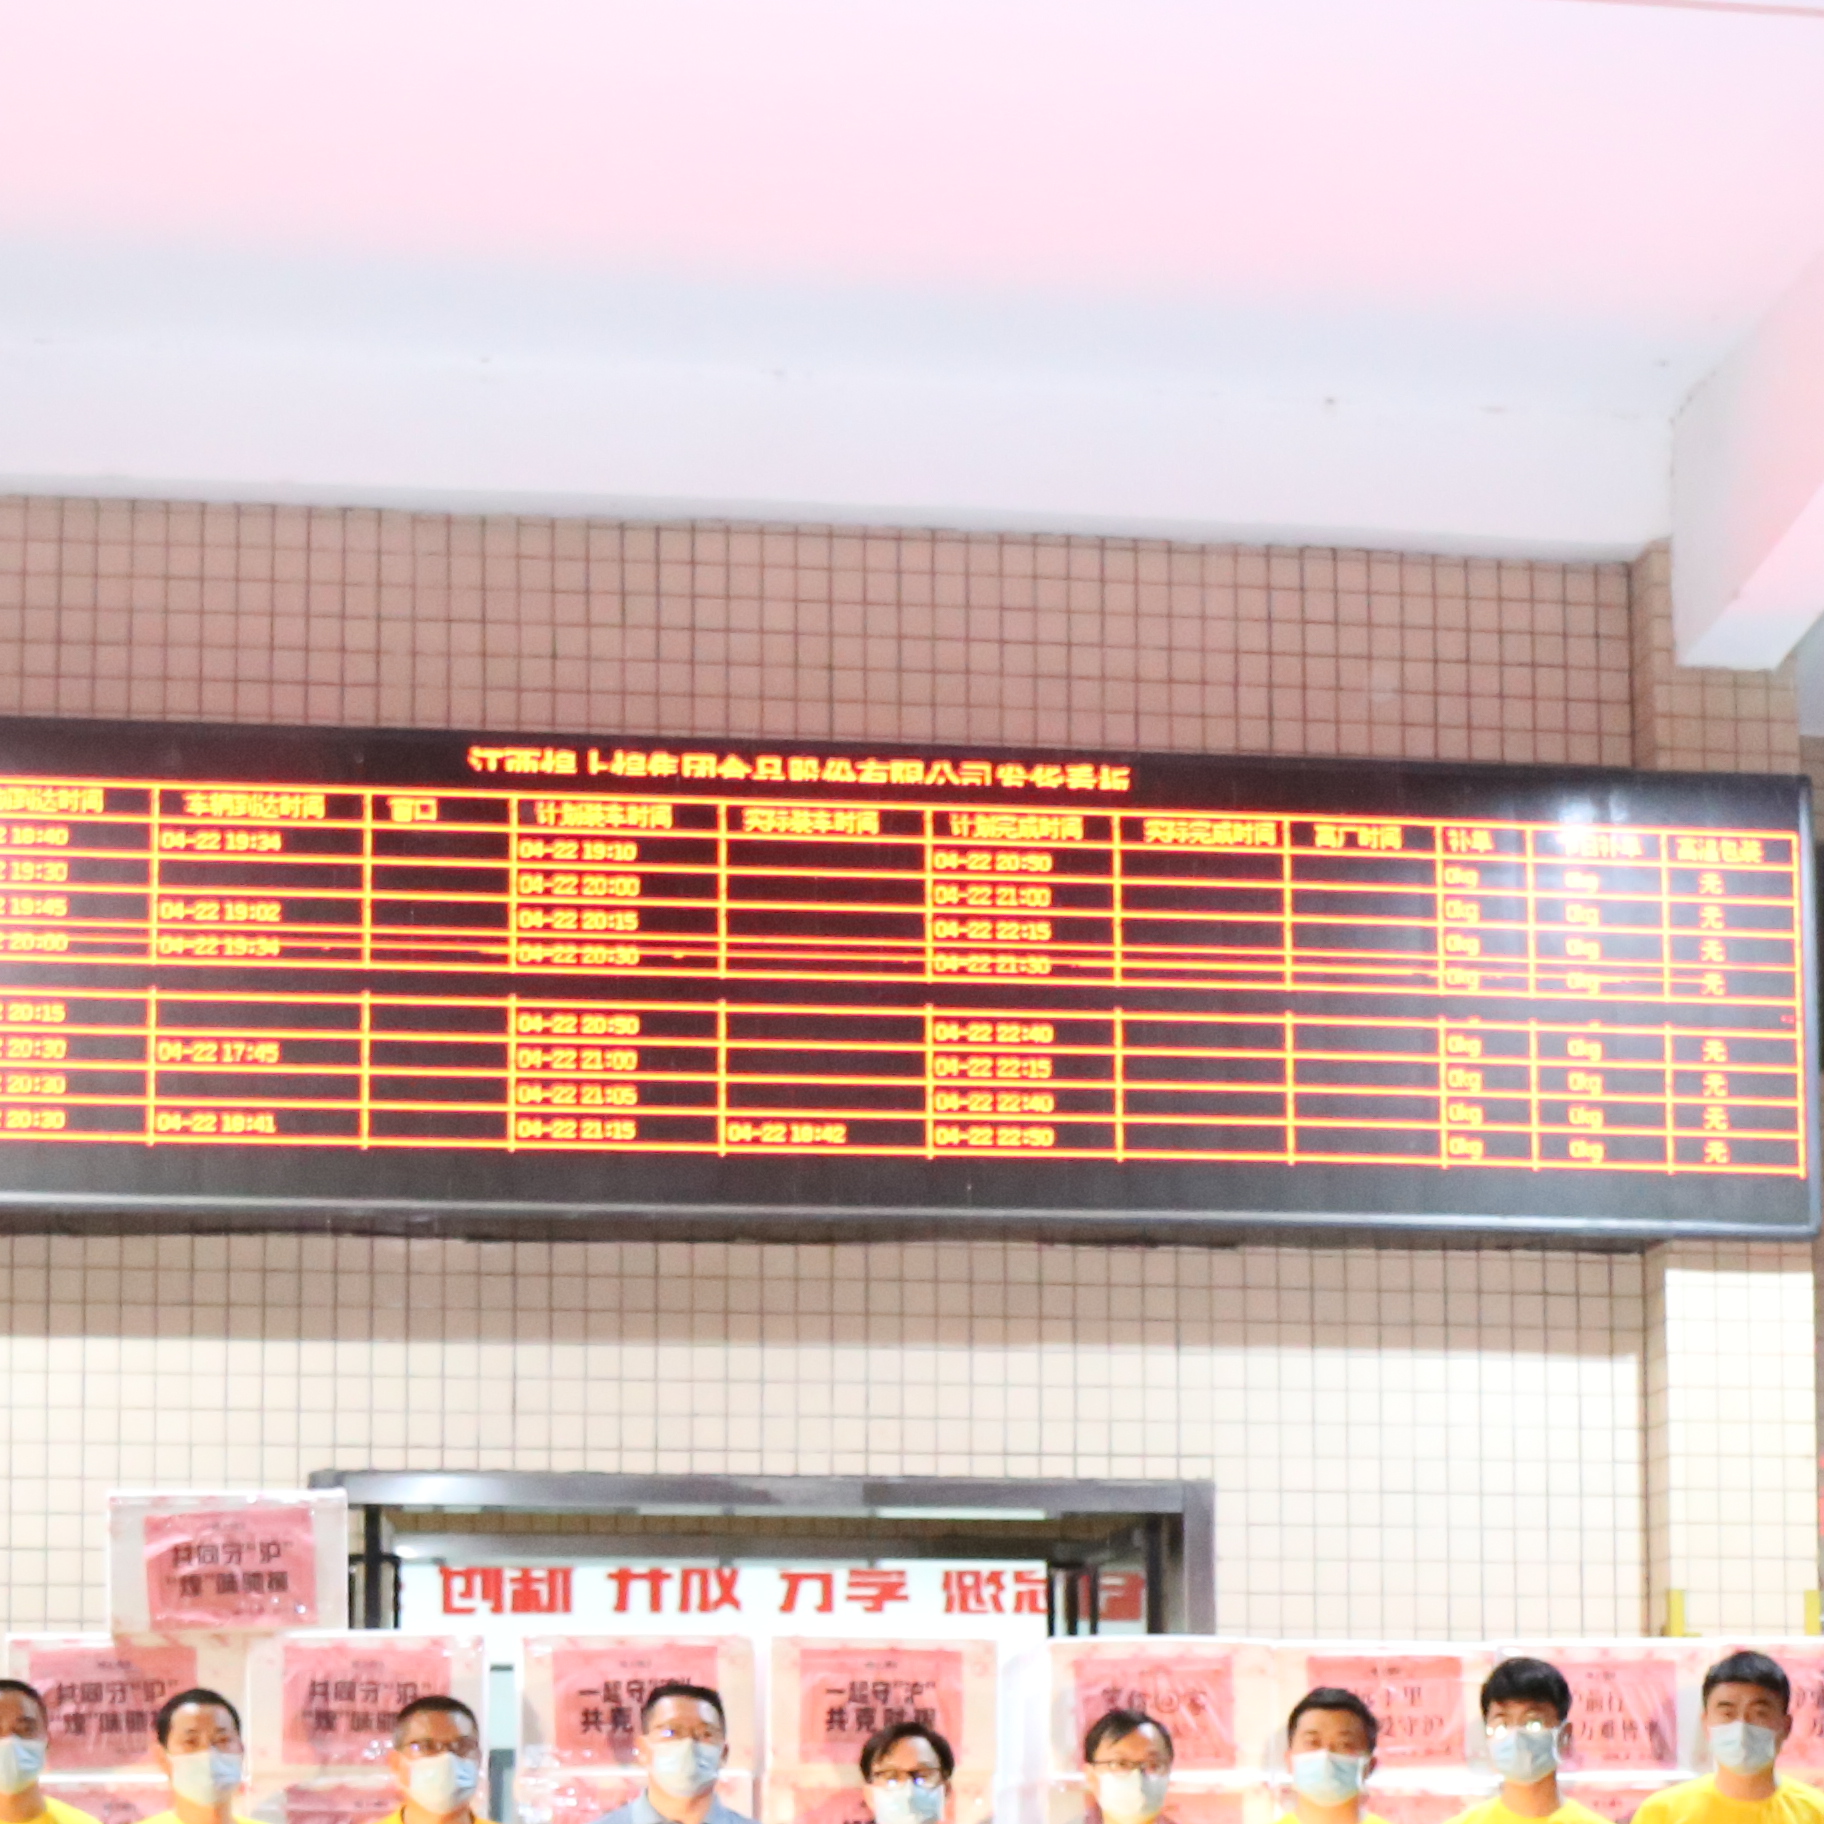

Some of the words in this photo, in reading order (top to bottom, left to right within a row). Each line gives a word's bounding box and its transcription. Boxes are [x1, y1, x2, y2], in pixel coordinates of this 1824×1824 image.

[184, 792, 327, 820] 车辆到达时间
[386, 797, 440, 823] 窗口
[535, 802, 673, 830] 计划装车时间
[743, 808, 881, 836] 实际装车时间
[949, 813, 1085, 841] 计划完成时间
[1143, 818, 1277, 847] 实际完成时间
[160, 830, 220, 852] 04-22
[518, 839, 578, 862] 04-22
[934, 852, 992, 873] 04-22
[518, 874, 578, 897] 04-22
[934, 886, 992, 908] 04-22
[160, 901, 220, 923] 04-22
[518, 909, 578, 931] 04-22
[934, 920, 992, 941] 04-22
[517, 1014, 577, 1036] 04-22
[935, 1023, 993, 1044] 04-22
[156, 1042, 216, 1064] 04-22
[517, 1049, 577, 1072] 04-22
[935, 1057, 993, 1079] 04-22
[517, 1084, 577, 1106] 04-22
[935, 1092, 993, 1113] 04-22
[156, 1112, 216, 1134] 04-22
[517, 1119, 577, 1141] 04-22
[728, 1123, 786, 1145] 04-22
[935, 1126, 993, 1147] 04-22
